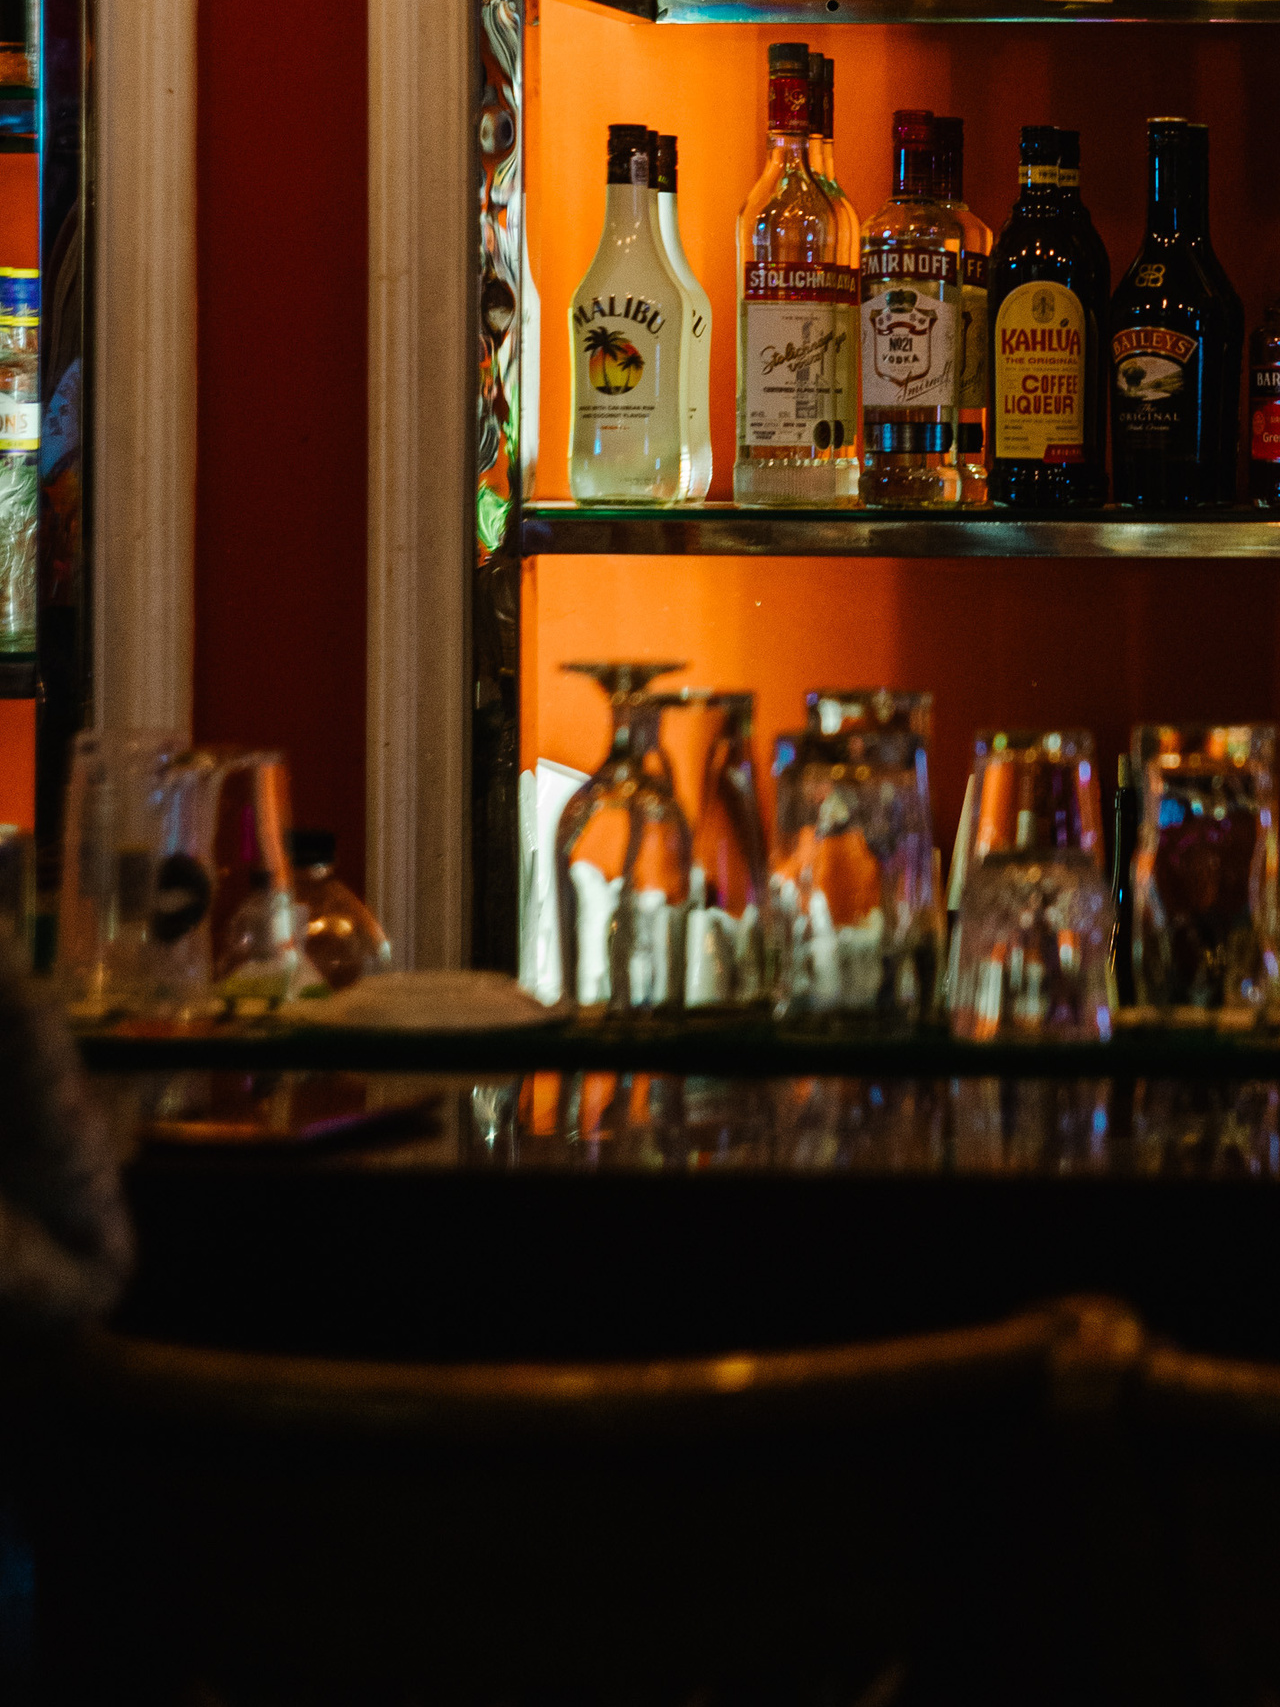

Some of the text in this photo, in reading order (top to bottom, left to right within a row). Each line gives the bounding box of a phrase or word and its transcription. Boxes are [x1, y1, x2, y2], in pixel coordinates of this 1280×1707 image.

[861, 253, 950, 275] SMIRNOFF
[573, 295, 666, 334] MALIBU
[1112, 332, 1188, 356] BAILEYS
[882, 354, 920, 364] VODKA
[1028, 357, 1078, 365] ORIGINAL
[1021, 374, 1078, 394] COFFEE
[1004, 395, 1074, 415] LIQUEUR
